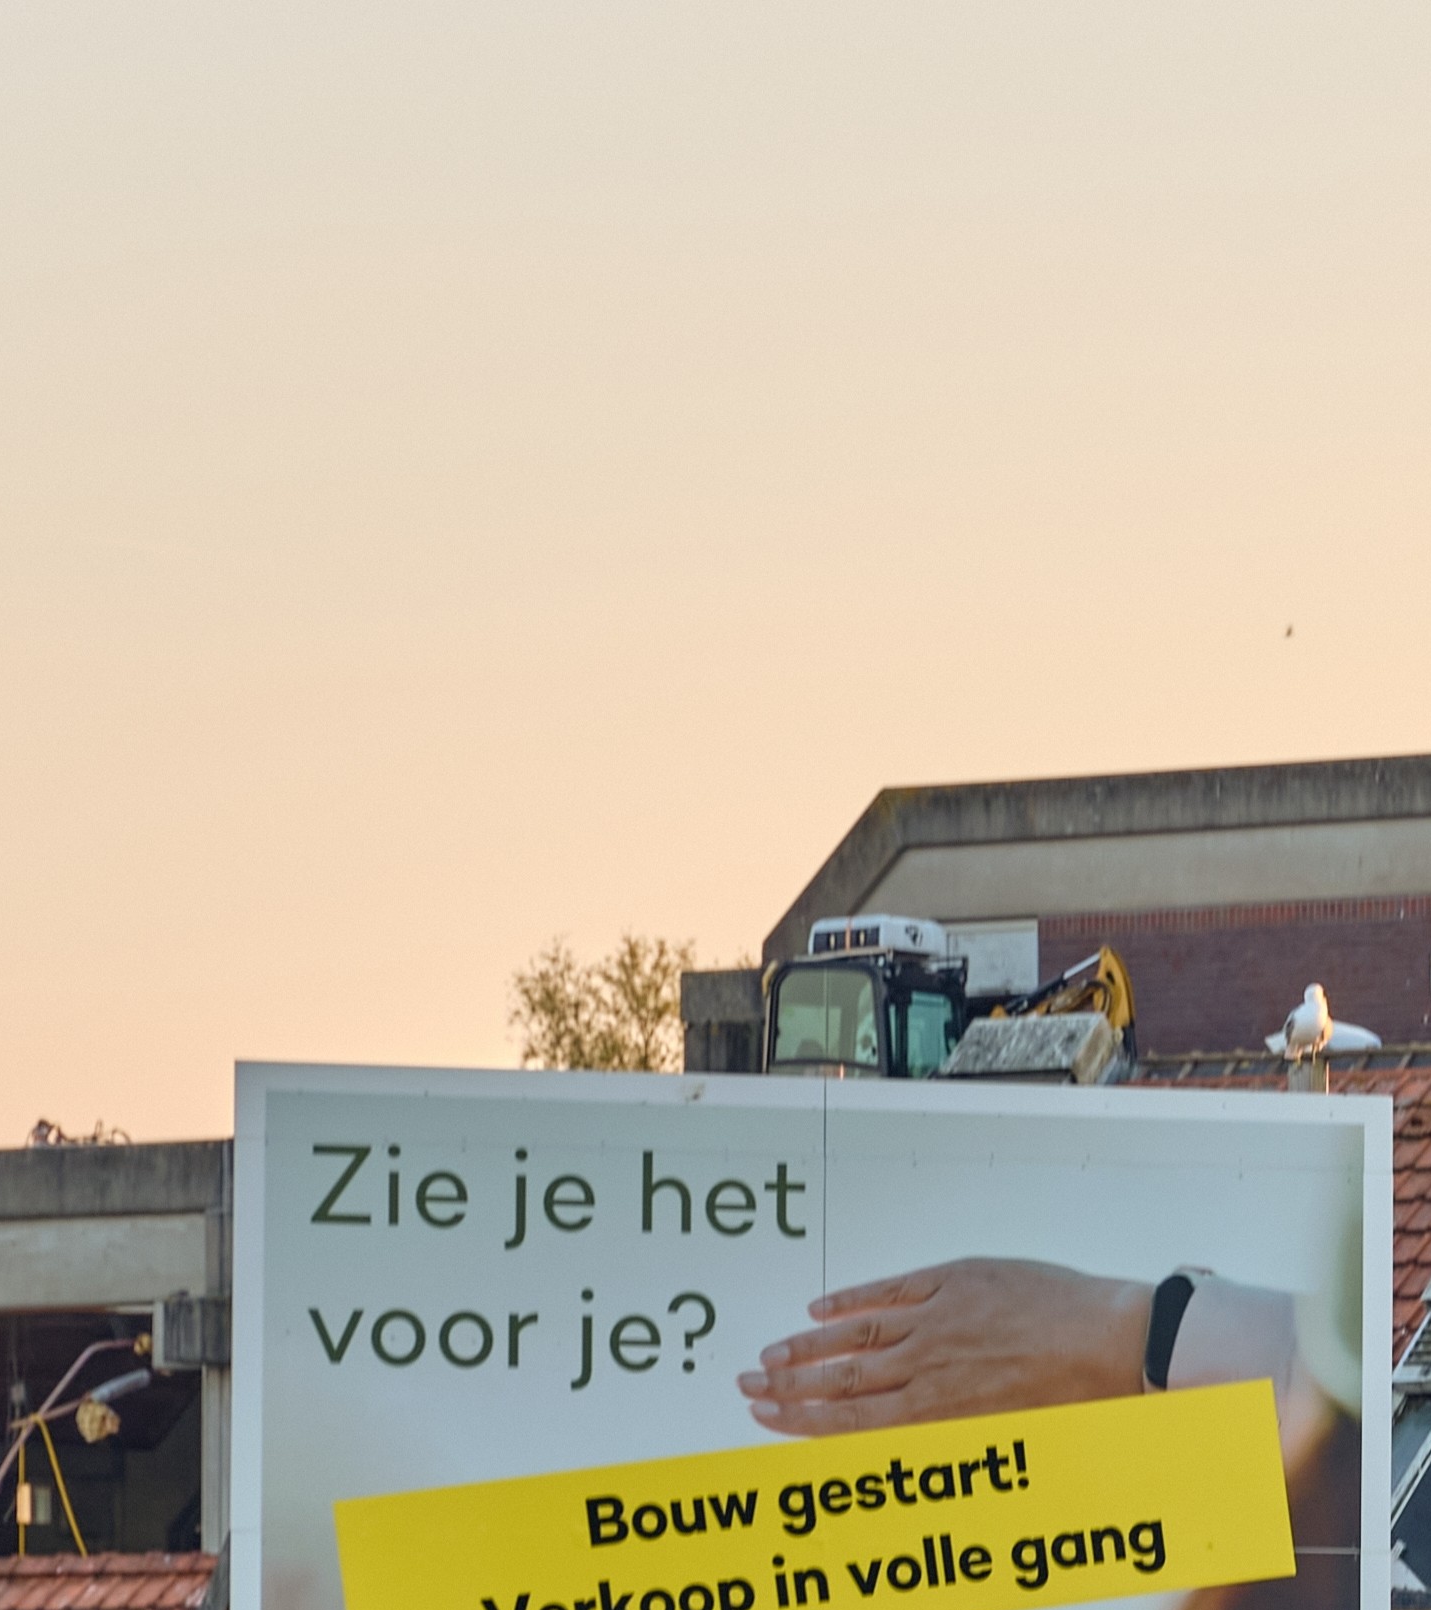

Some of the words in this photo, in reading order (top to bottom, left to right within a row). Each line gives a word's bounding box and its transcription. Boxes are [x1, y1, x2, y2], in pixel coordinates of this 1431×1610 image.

[310, 1144, 469, 1229] Zie
[504, 1147, 596, 1250] je
[642, 1149, 806, 1239] het
[308, 1307, 539, 1369] voor
[571, 1288, 716, 1391] je?
[584, 1487, 759, 1547] Bouw
[778, 1440, 1030, 1535] gestart!
[772, 1555, 830, 1609] in
[846, 1533, 993, 1597] volle
[1010, 1518, 1167, 1590] gang
